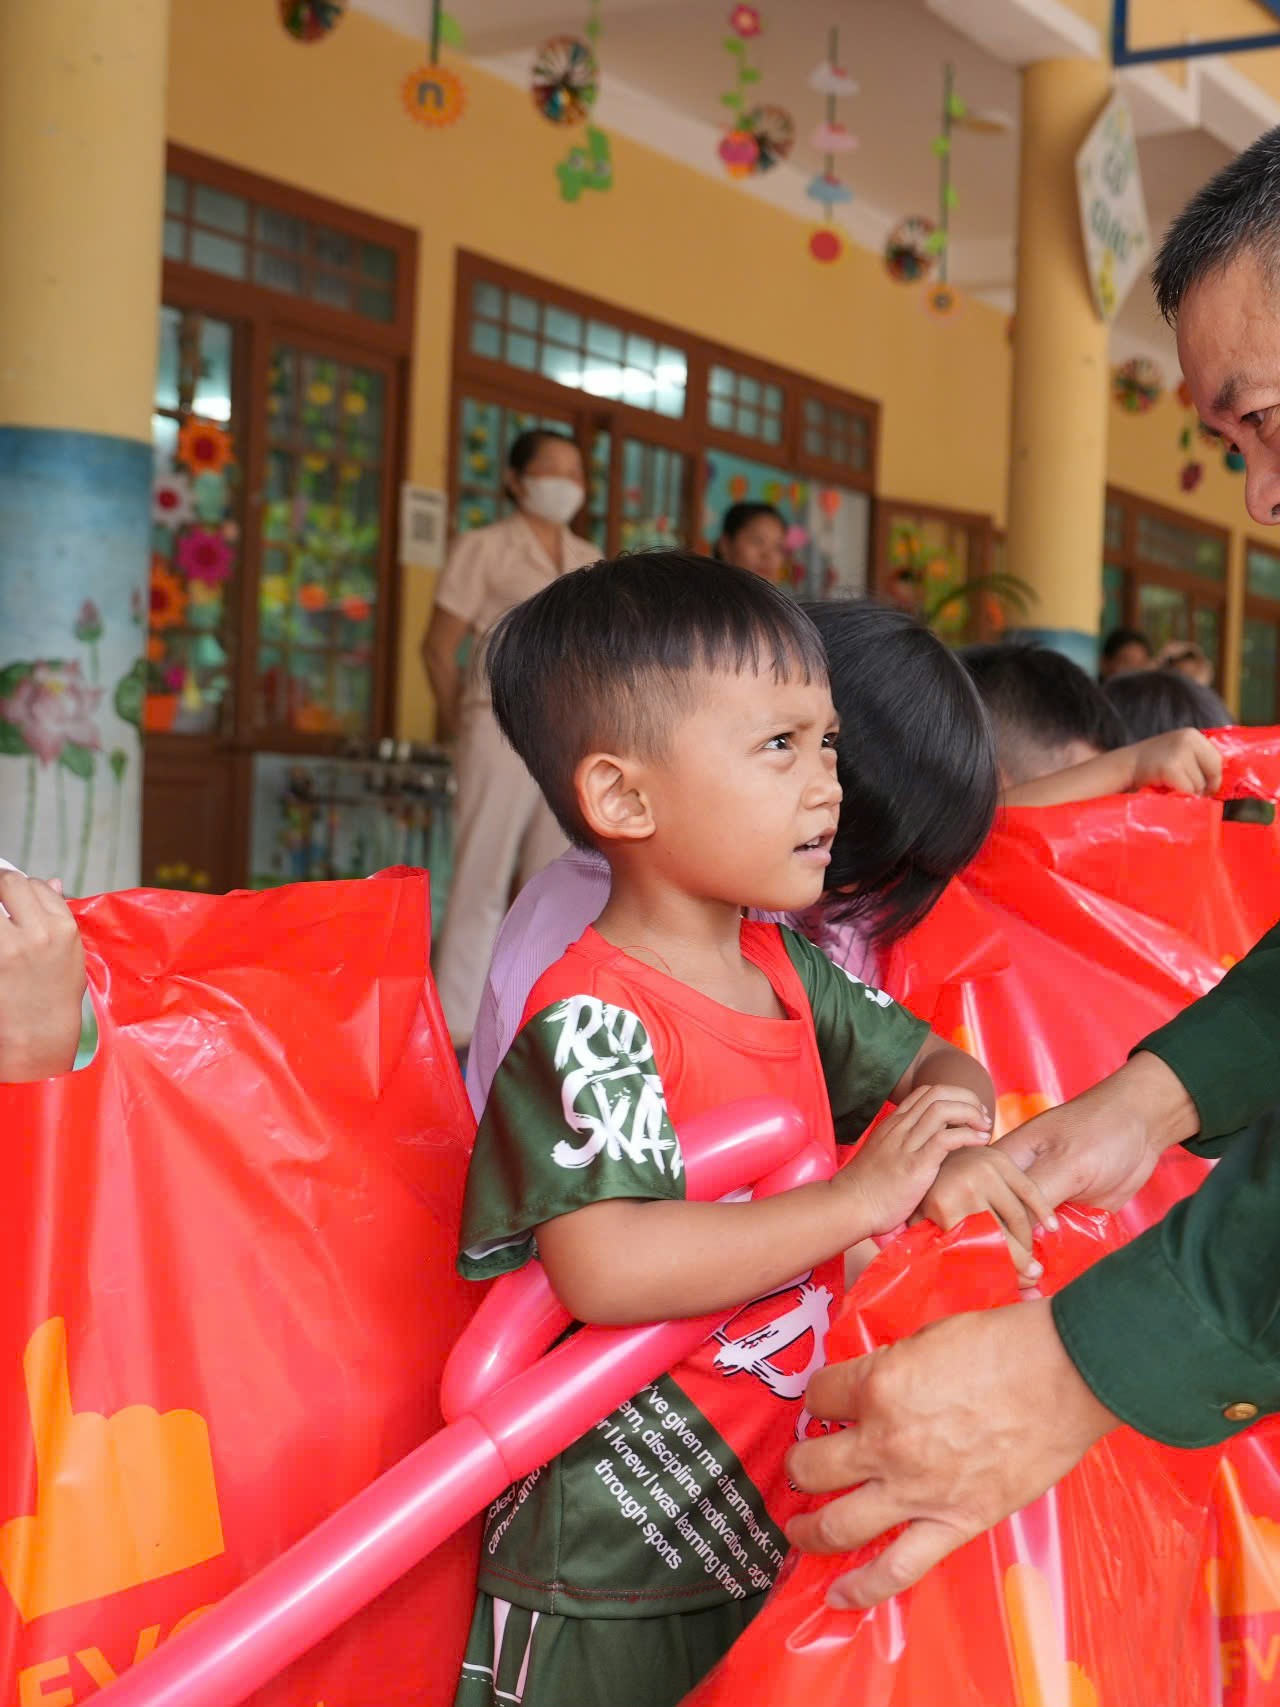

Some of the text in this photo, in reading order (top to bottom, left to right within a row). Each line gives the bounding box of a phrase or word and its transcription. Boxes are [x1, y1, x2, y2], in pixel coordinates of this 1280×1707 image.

[604, 1426, 620, 1439] I
[661, 1412, 703, 1453] given
[697, 1449, 723, 1477] me
[610, 1434, 650, 1479] knew
[641, 1429, 702, 1504] discipline,
[698, 1497, 748, 1568] motivation.
[642, 1473, 659, 1487] I
[649, 1482, 681, 1519] was
[594, 1458, 682, 1570] through sports
[674, 1512, 720, 1574] learning
[715, 1563, 747, 1600] them
